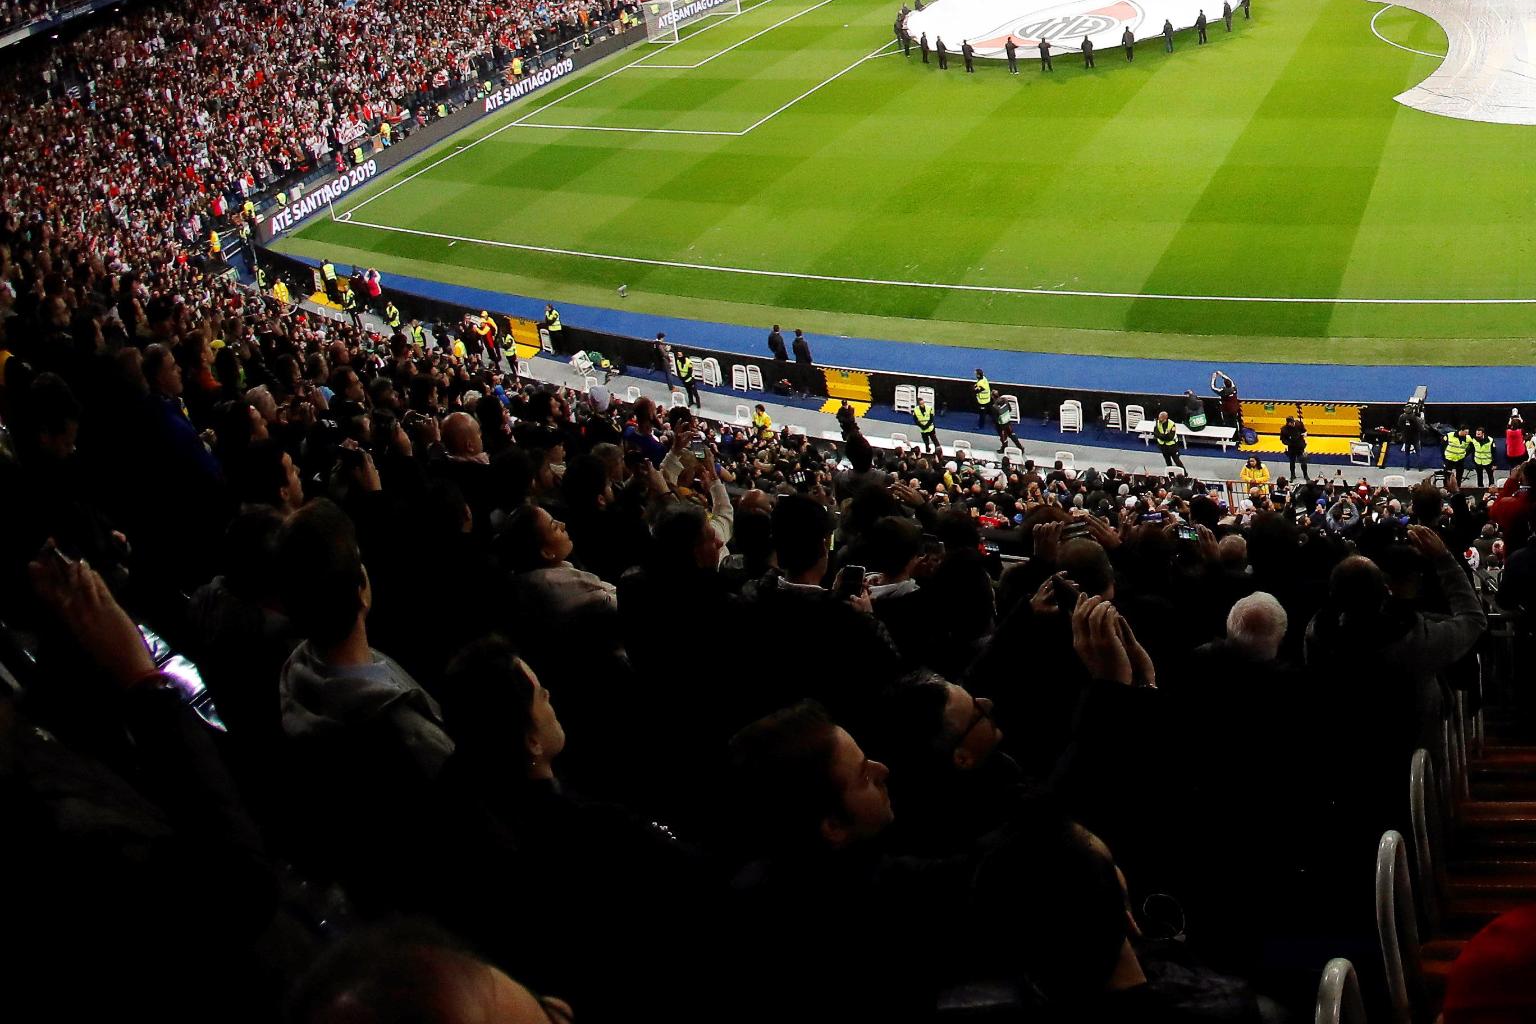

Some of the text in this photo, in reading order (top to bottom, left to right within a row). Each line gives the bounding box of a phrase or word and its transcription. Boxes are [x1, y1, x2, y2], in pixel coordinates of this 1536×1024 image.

[485, 58, 573, 112] ATÉ SANTIAGO 2019
[272, 159, 377, 235] ATÉ SANTIAGO 2019
